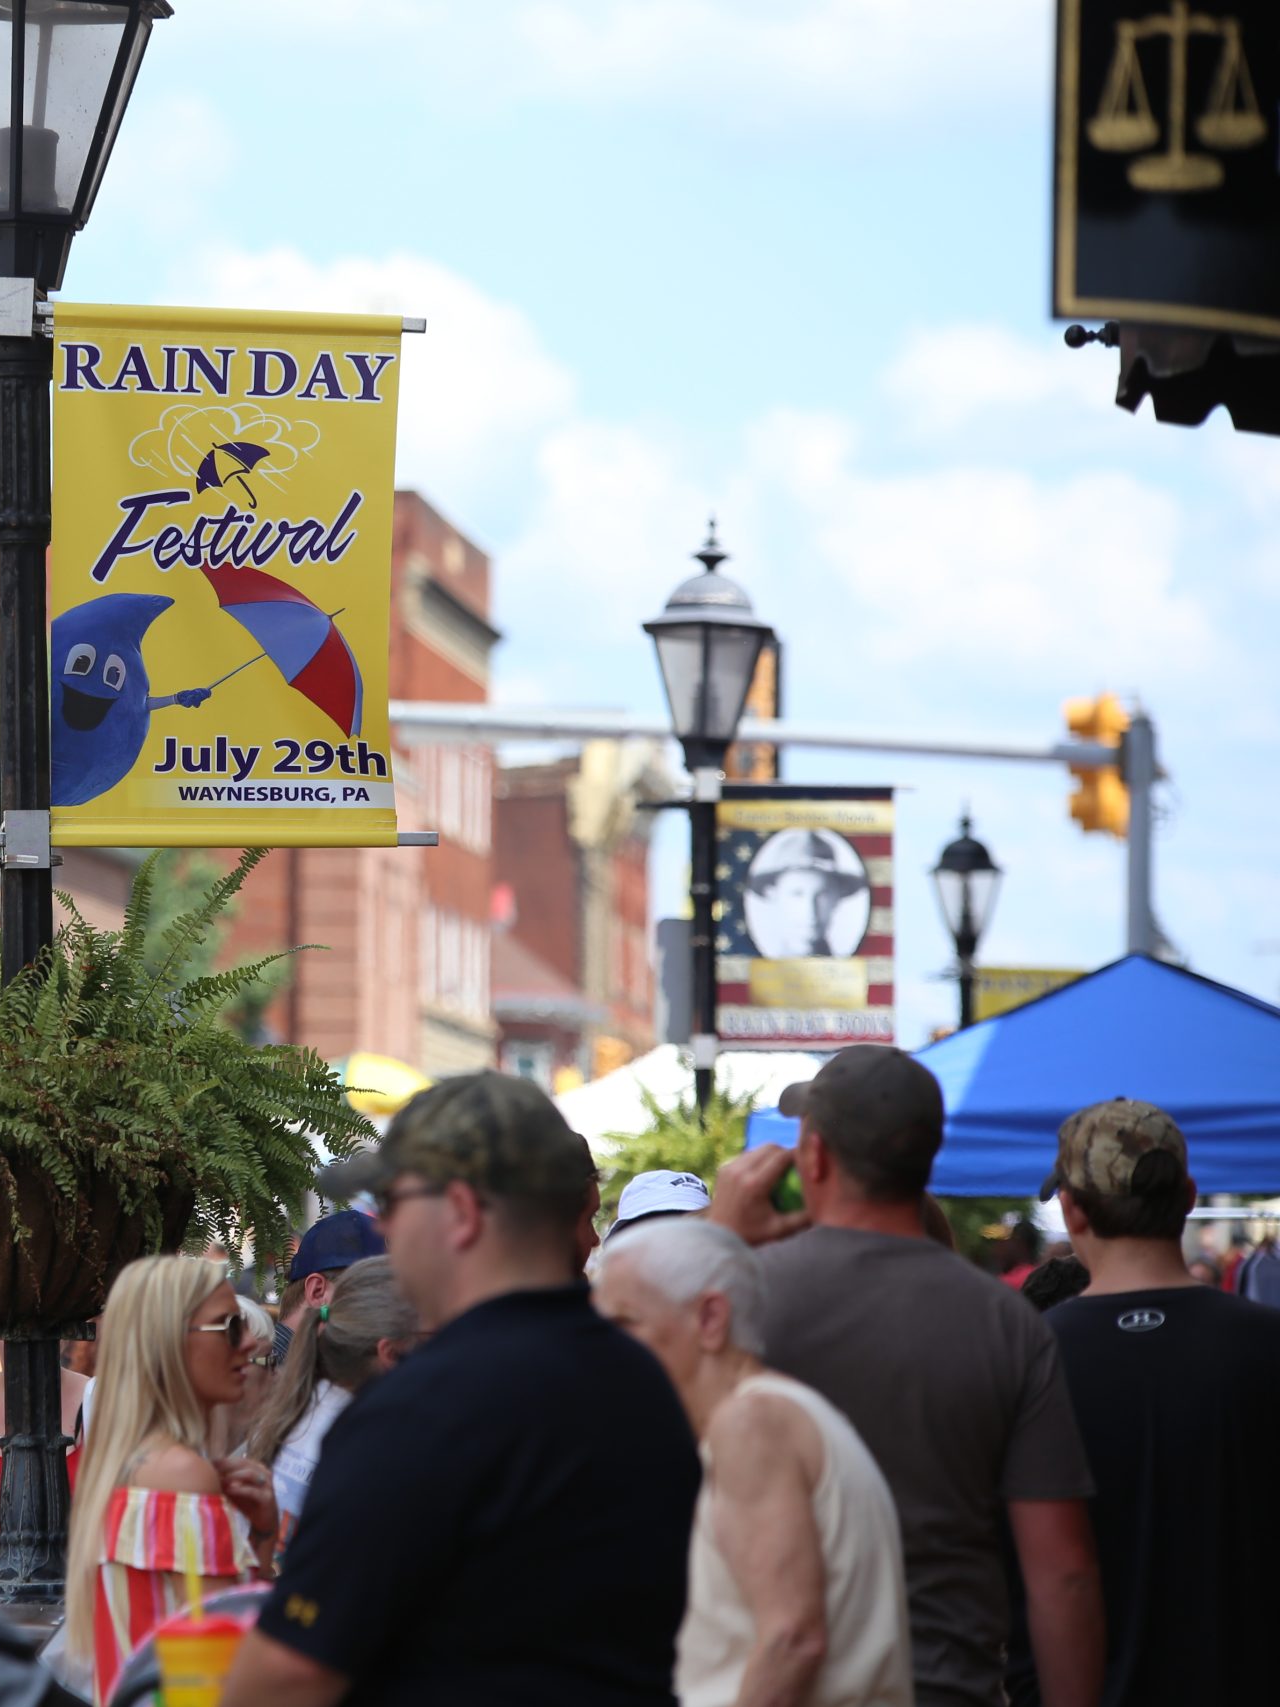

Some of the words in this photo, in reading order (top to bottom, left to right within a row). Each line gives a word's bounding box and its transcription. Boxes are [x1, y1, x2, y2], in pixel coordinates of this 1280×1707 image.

[60, 344, 235, 396] RAIN
[246, 348, 395, 402] DAY
[91, 489, 364, 584] Festival
[153, 735, 261, 781] July
[272, 738, 388, 777] 29th
[178, 785, 337, 803] WAYNESBURG,
[343, 788, 370, 802] PA
